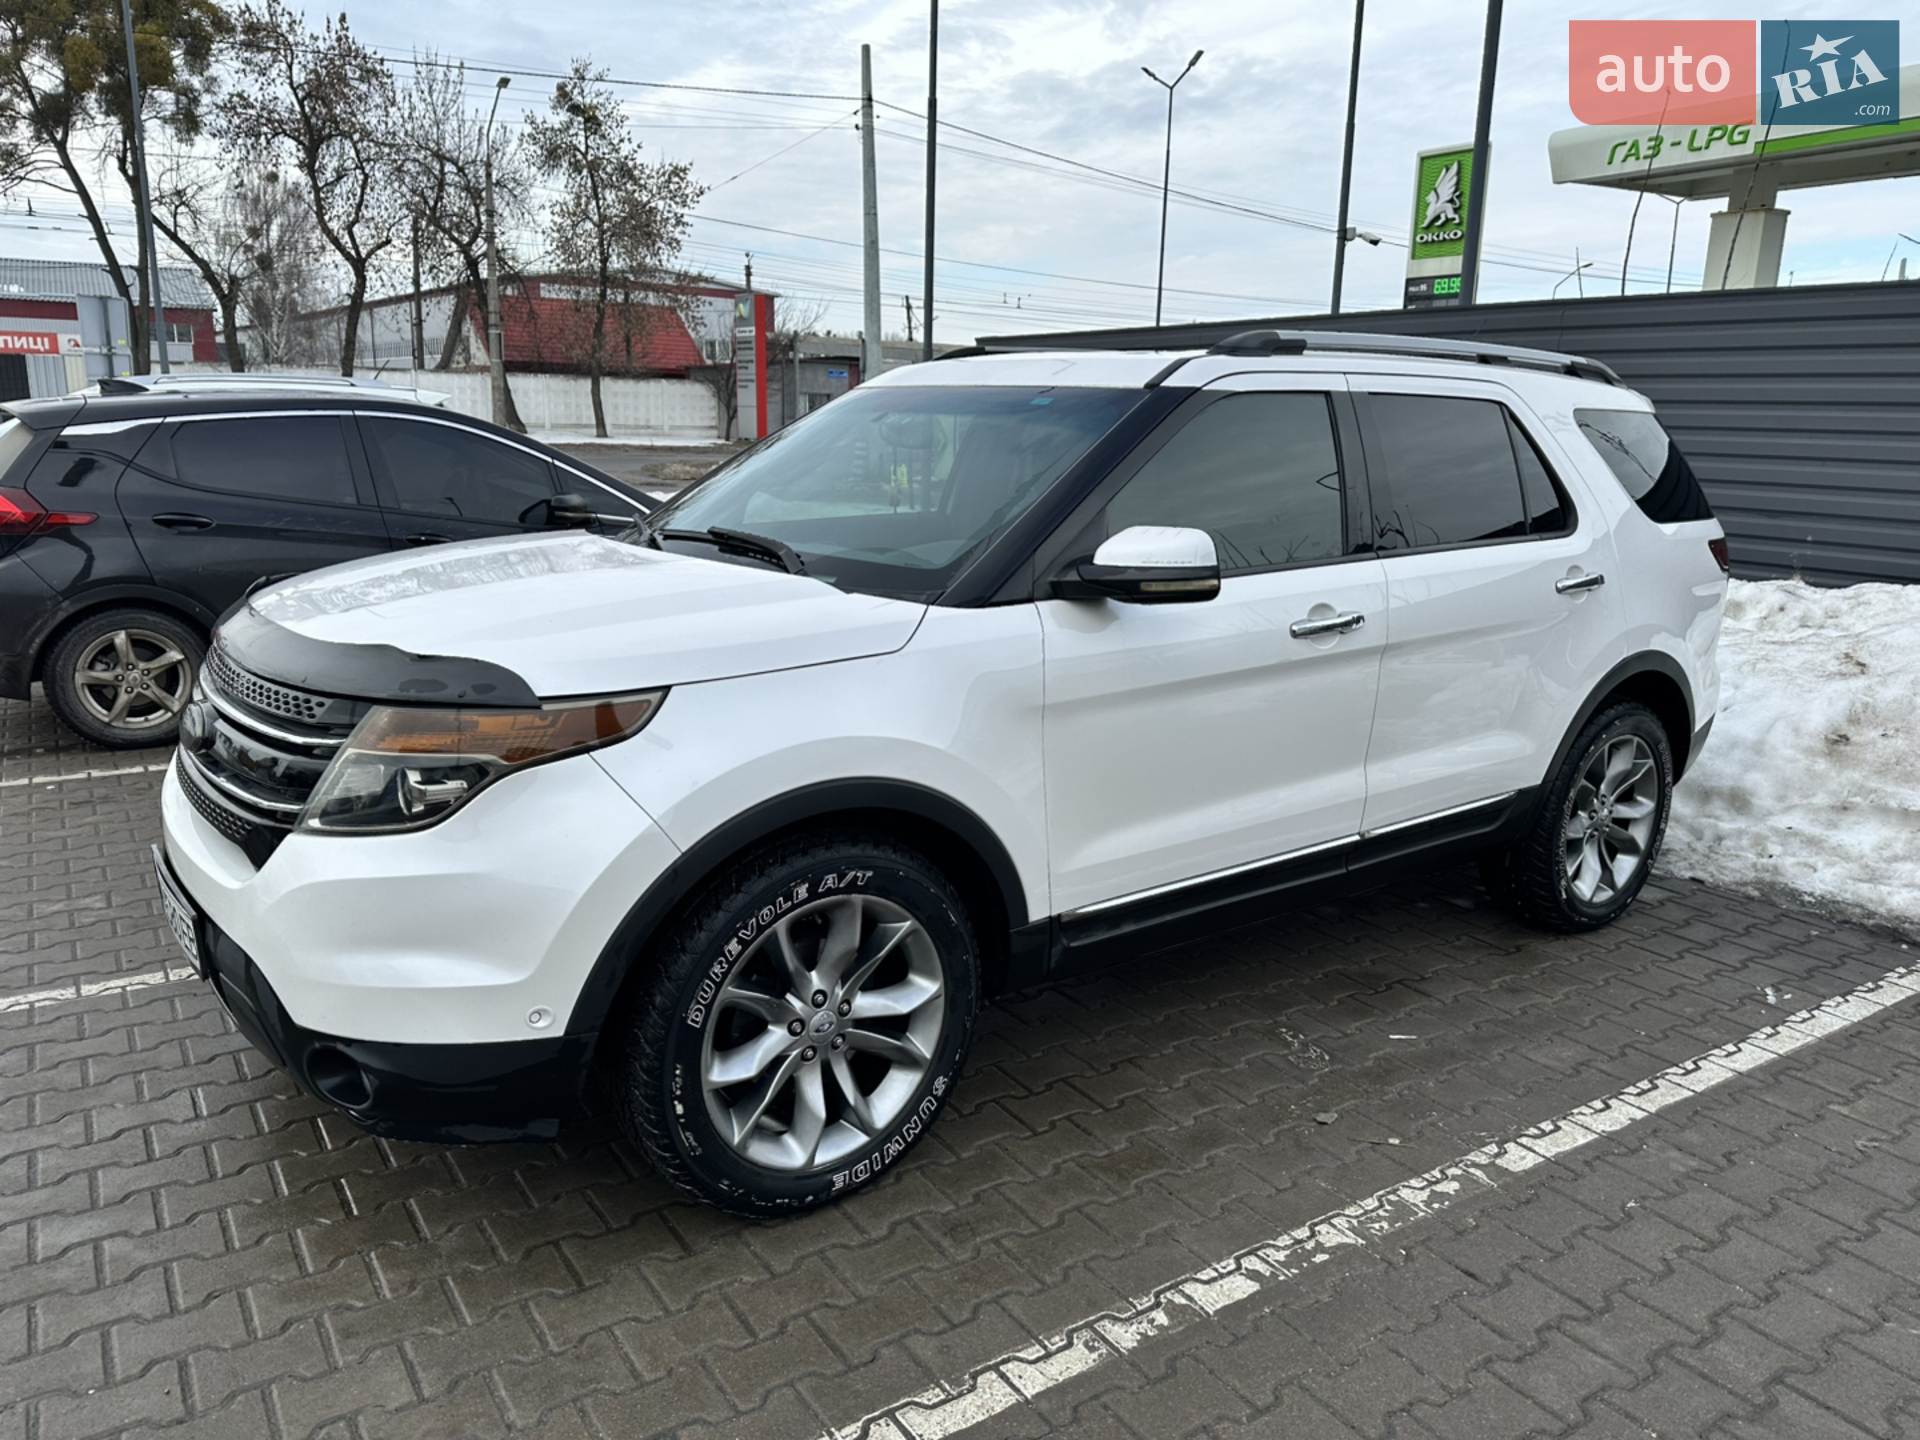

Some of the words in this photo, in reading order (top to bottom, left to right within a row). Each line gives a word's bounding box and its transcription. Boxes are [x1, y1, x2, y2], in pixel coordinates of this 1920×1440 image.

[1415, 229, 1463, 243] OKKO
[687, 882, 809, 1029] DUREVOLE
[818, 870, 874, 893] A/T
[832, 1075, 949, 1192] SUNWIDE
